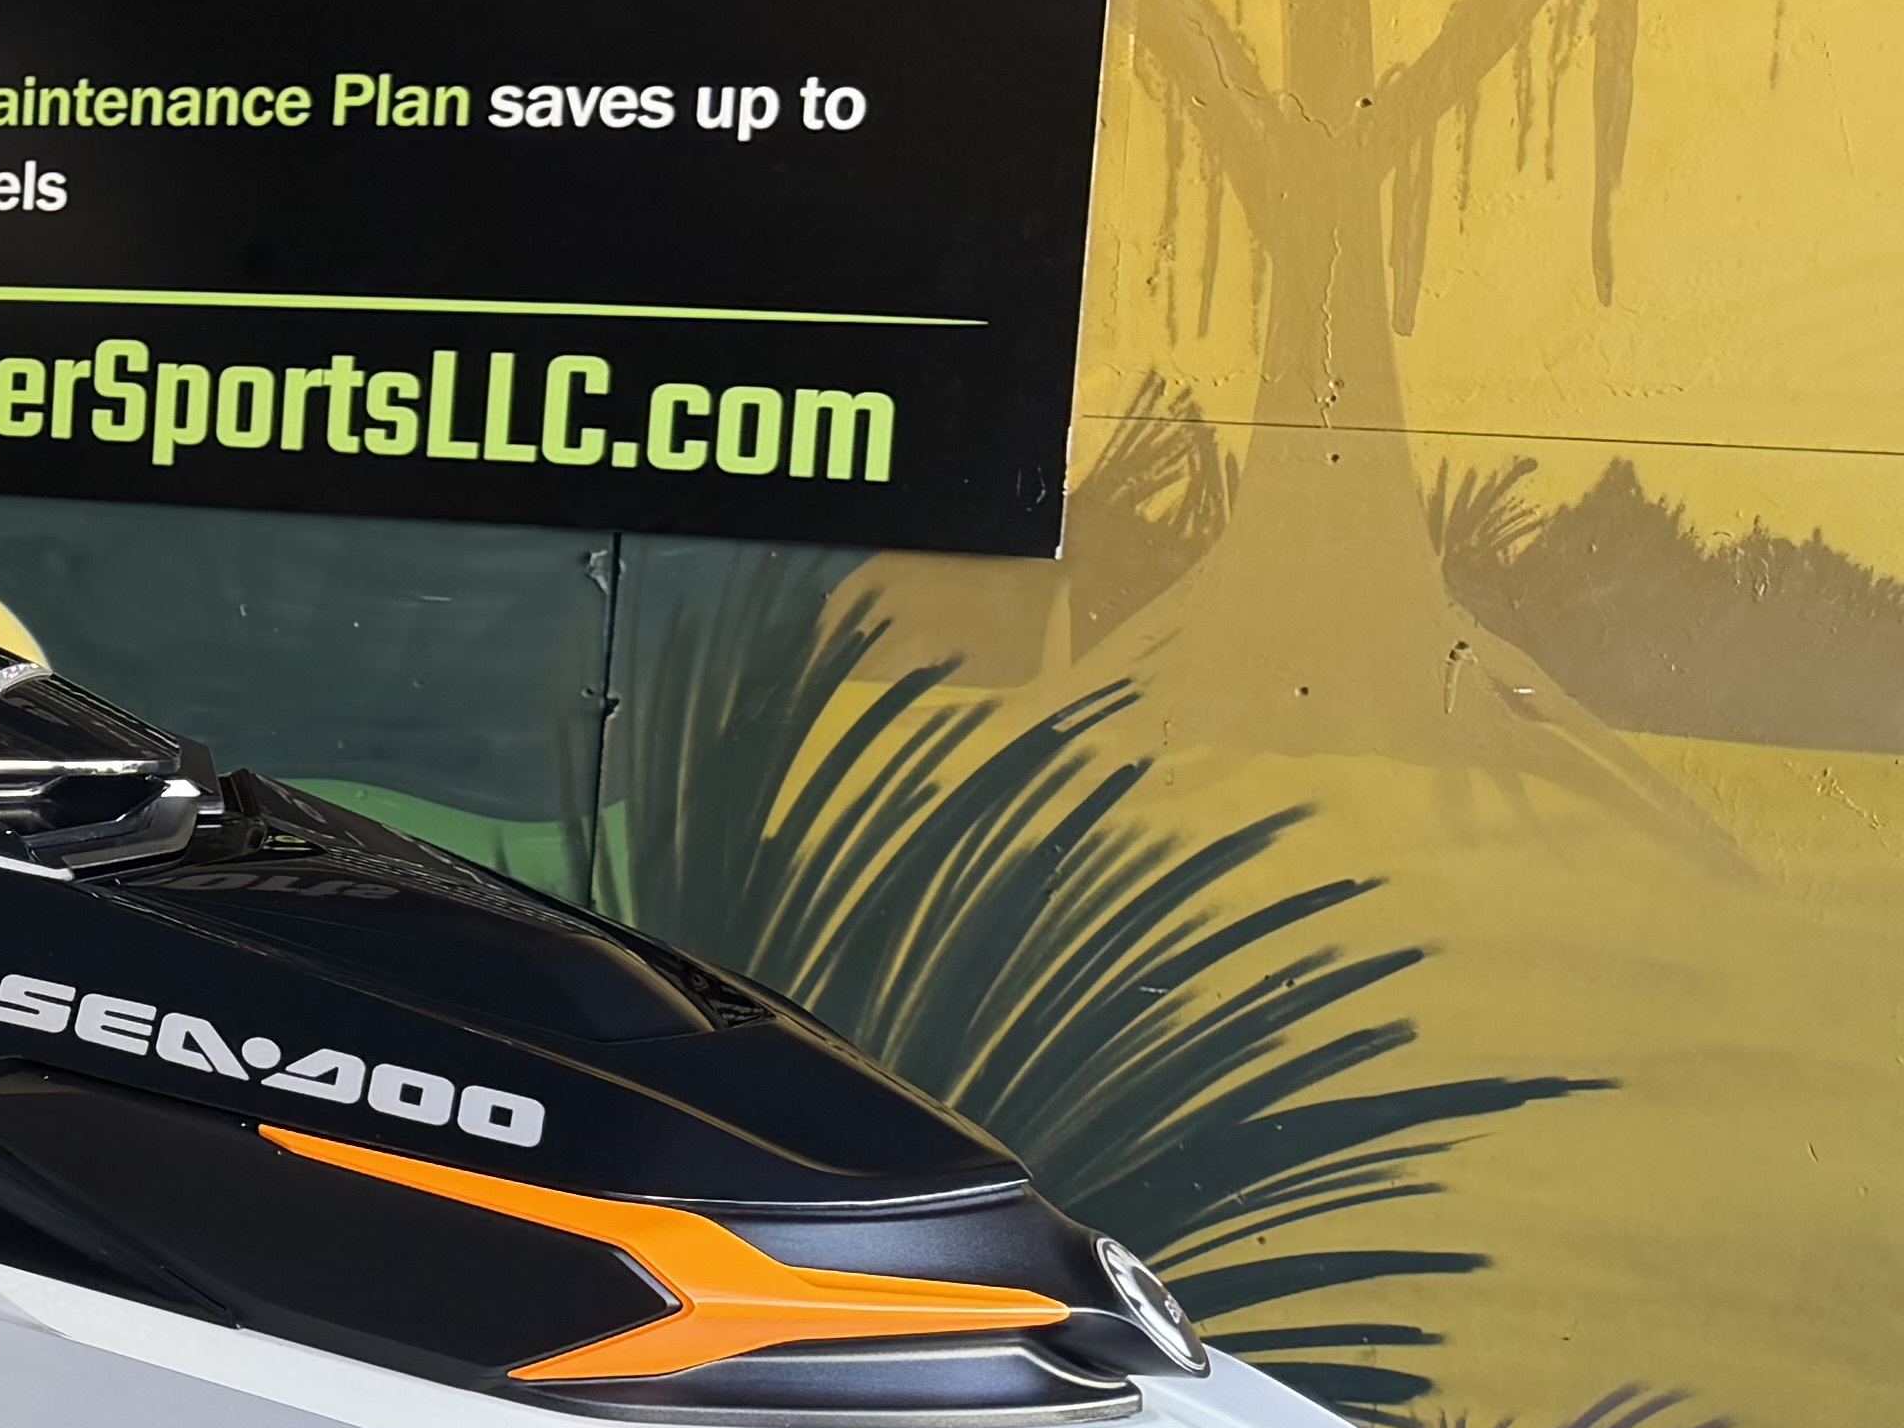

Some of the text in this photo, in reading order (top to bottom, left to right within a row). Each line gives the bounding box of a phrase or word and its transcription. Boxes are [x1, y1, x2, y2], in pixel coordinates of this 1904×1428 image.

[332, 73, 470, 127] Plan
[488, 85, 675, 129] saves
[696, 86, 780, 142] up
[799, 76, 867, 131] to
